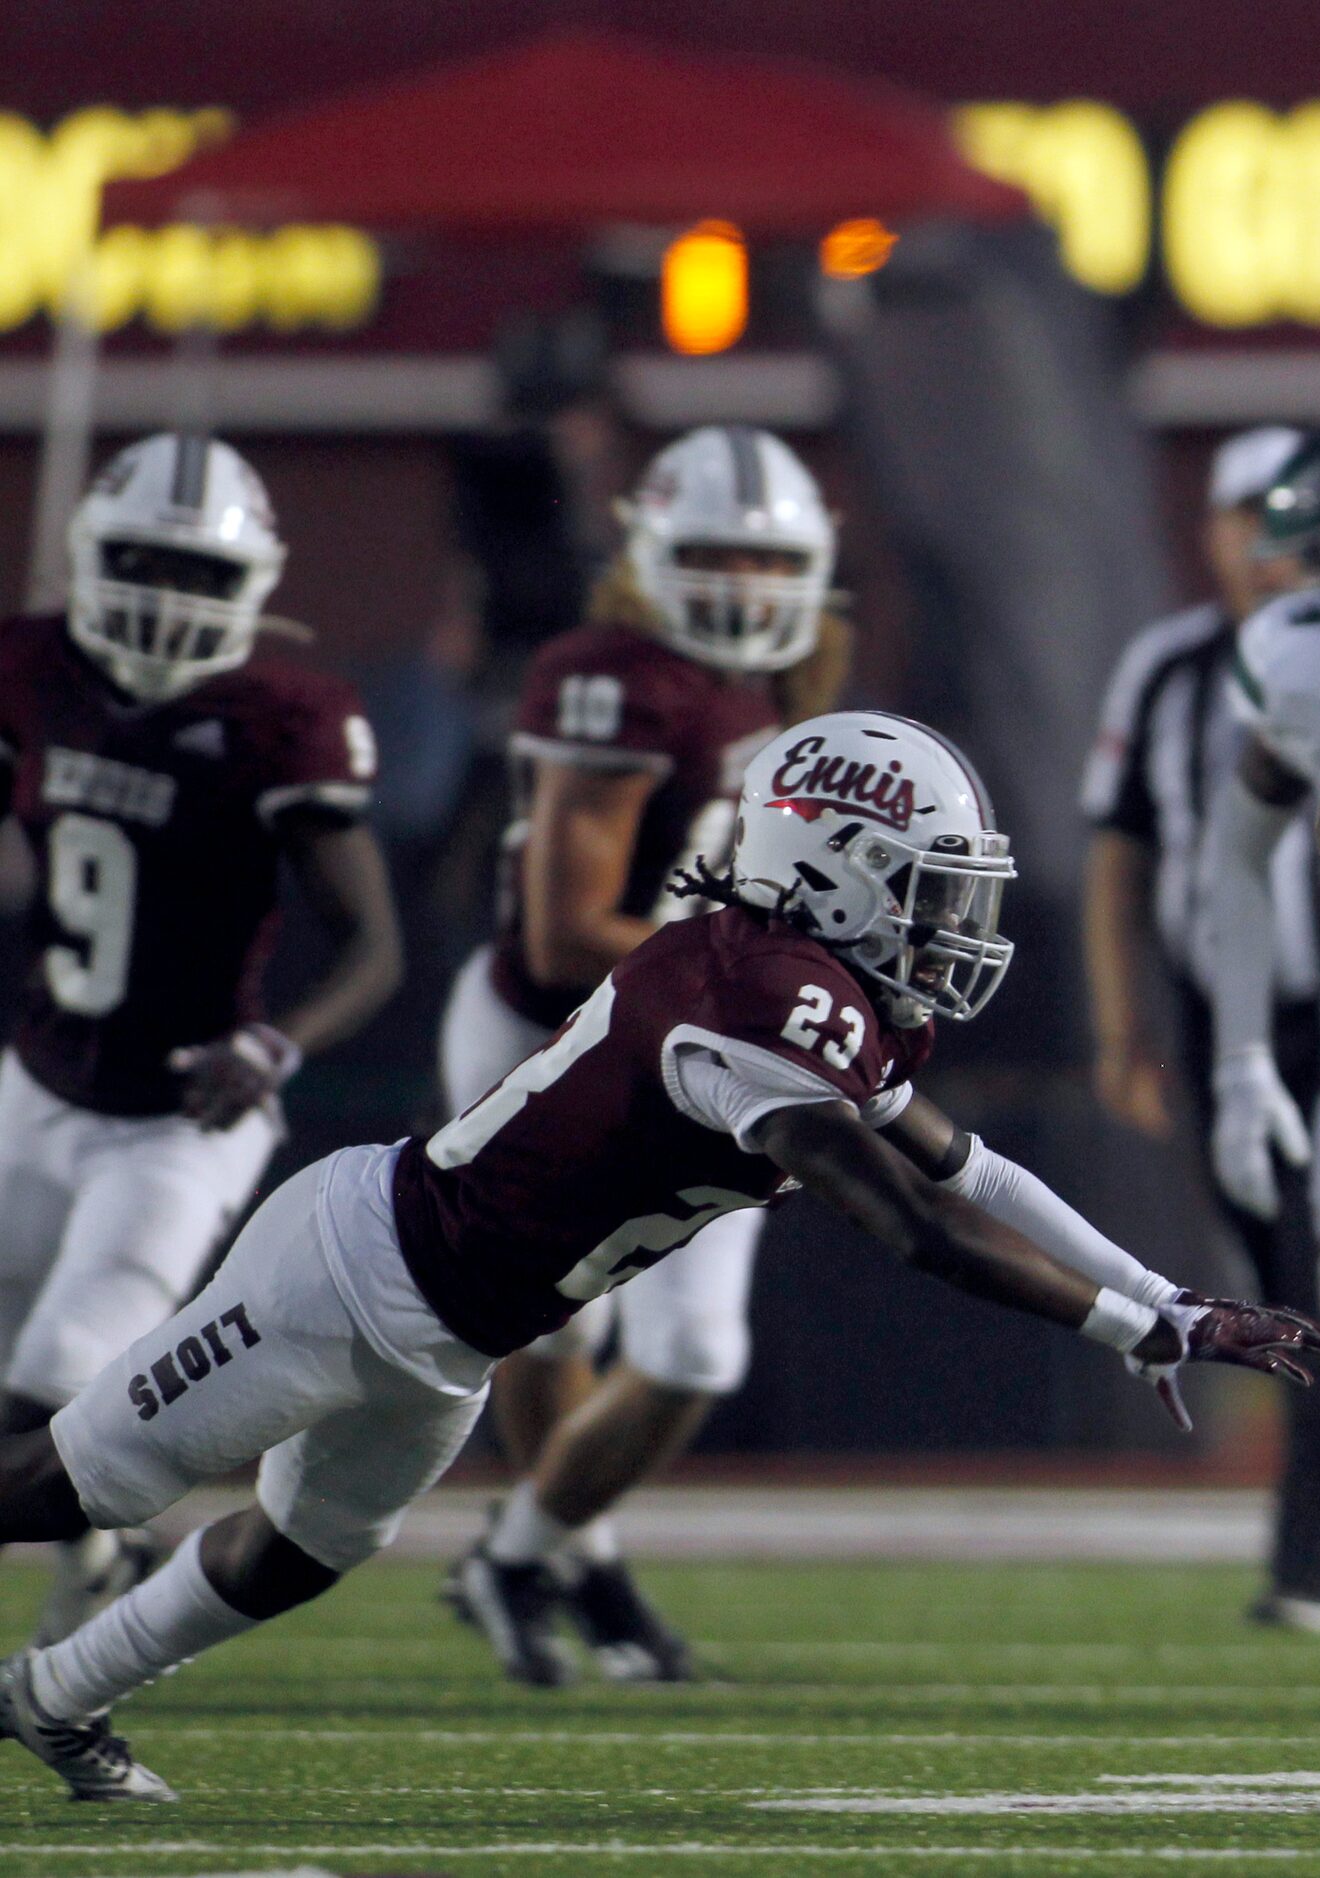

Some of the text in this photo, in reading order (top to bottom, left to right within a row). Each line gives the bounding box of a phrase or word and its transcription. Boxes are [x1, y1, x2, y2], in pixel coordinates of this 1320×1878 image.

[771, 736, 915, 823] Ennis
[45, 811, 138, 1018] 9
[779, 983, 866, 1070] 23
[127, 1301, 262, 1422] LIONS
